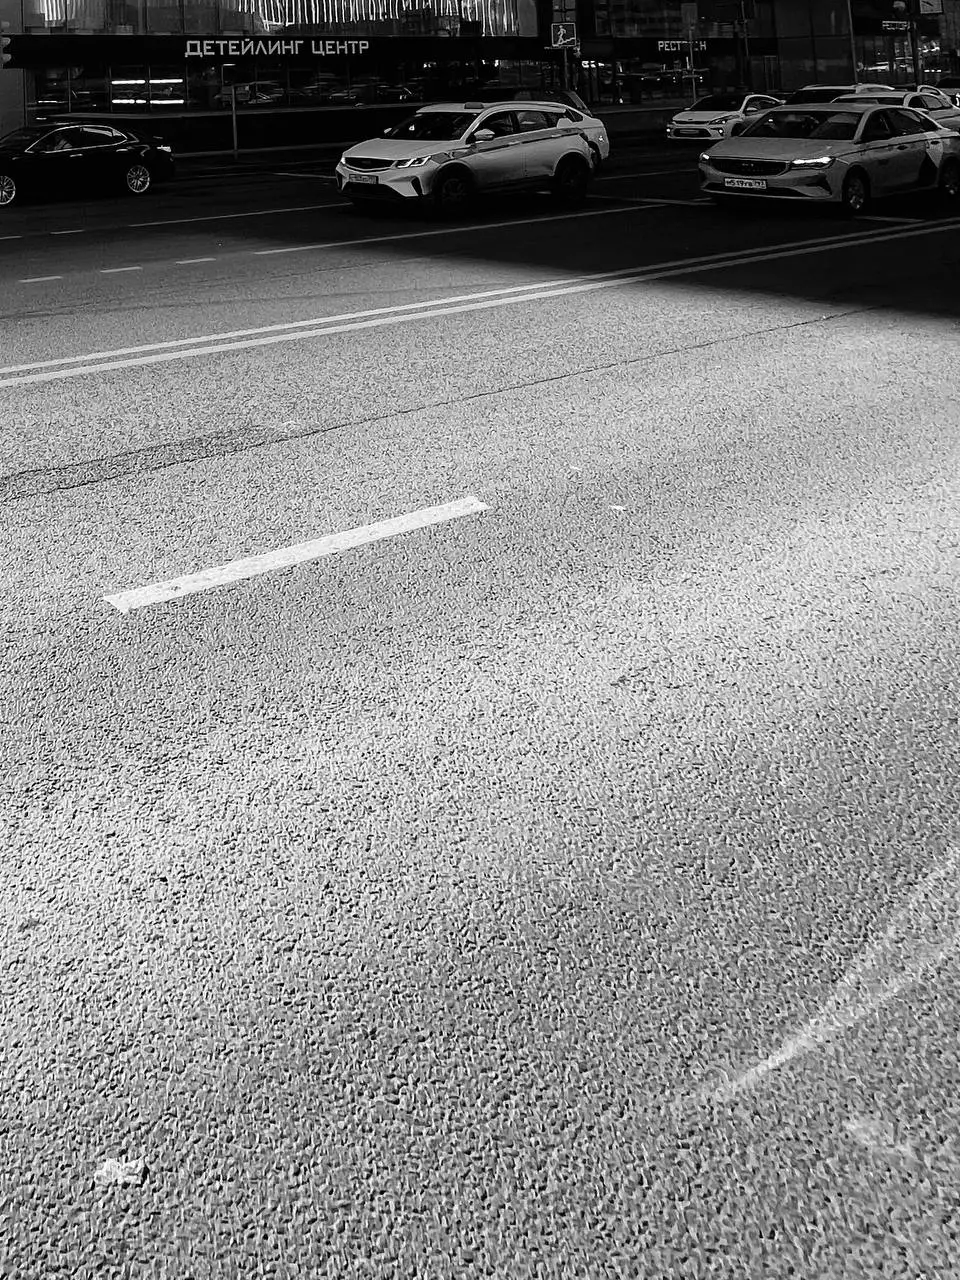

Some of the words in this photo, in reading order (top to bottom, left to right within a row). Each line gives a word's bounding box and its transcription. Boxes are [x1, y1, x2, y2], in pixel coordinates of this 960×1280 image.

[184, 39, 304, 58] ДЕТЕЙЛИНГ
[311, 40, 370, 57] ЦЕНТР
[658, 40, 707, 51] РЕСТН
